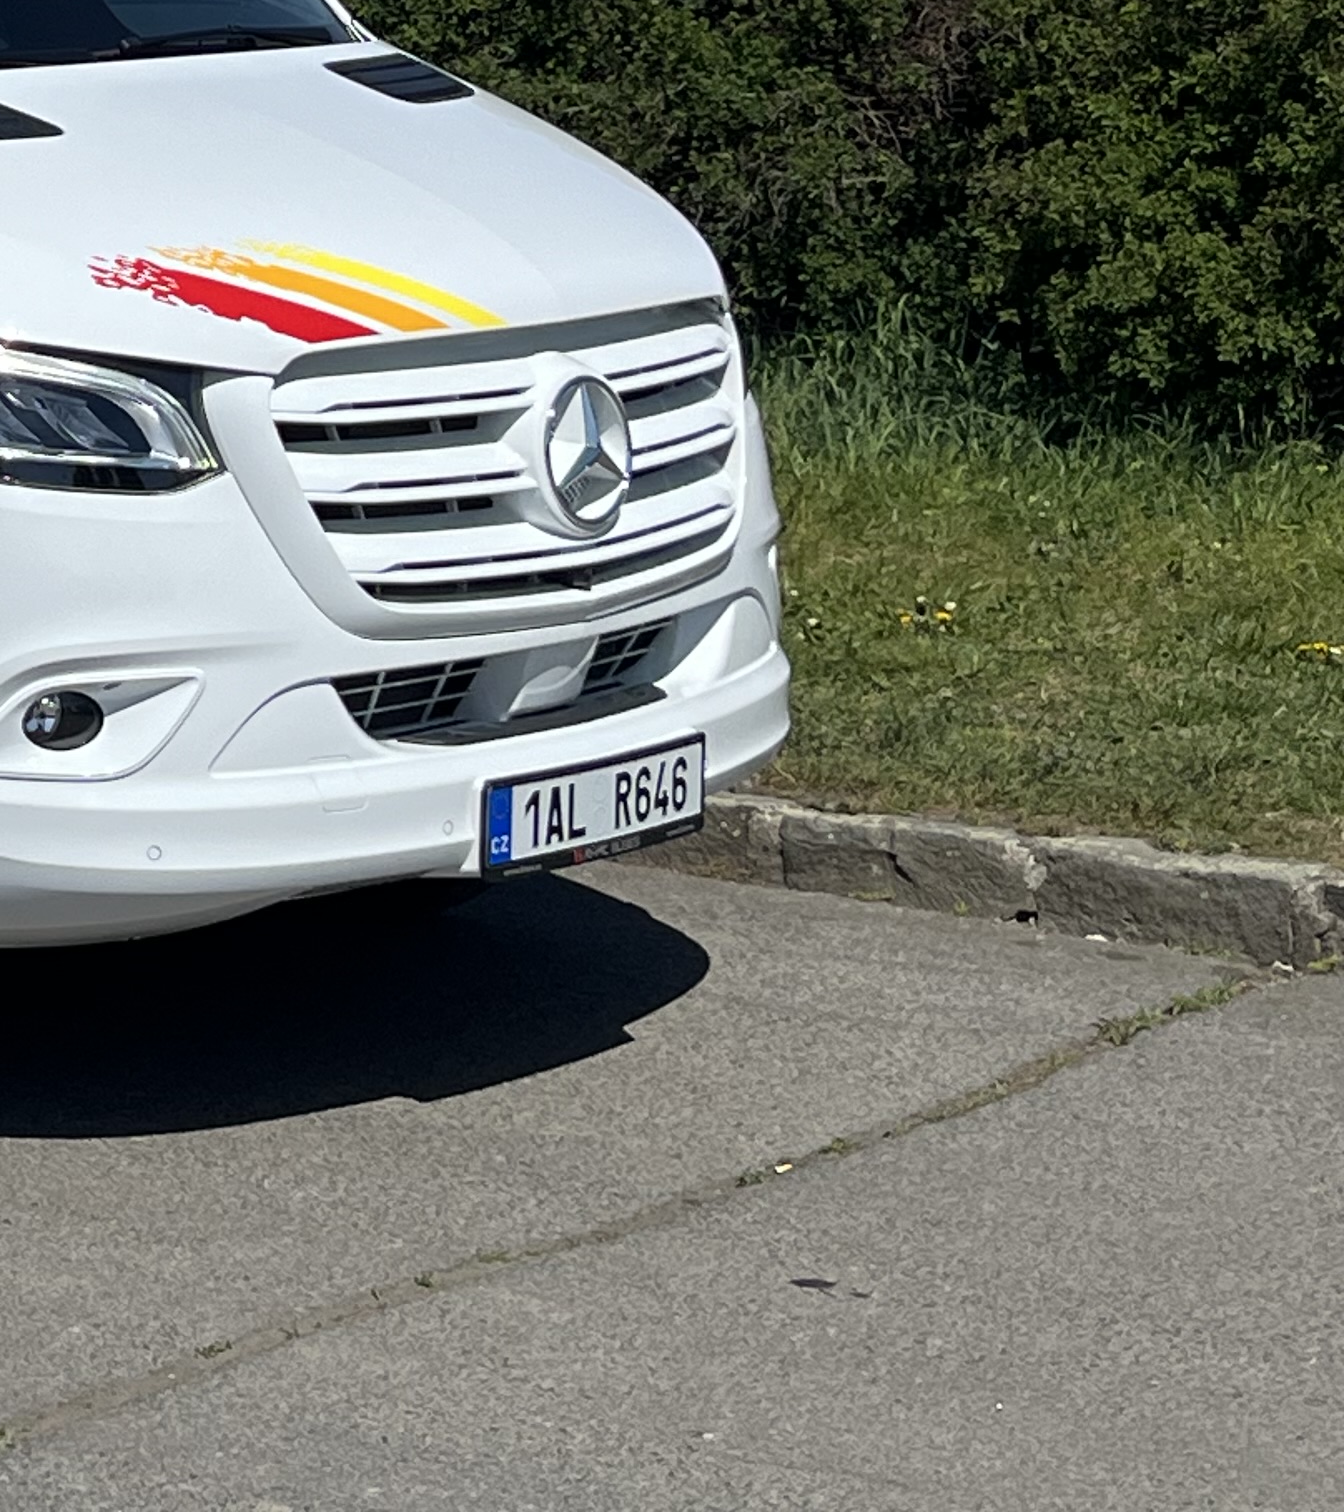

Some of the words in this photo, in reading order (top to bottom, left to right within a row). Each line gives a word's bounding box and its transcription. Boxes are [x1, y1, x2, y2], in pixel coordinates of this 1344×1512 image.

[490, 834, 510, 855] CZ
[524, 782, 587, 849] 1AL
[614, 756, 688, 830] R646
